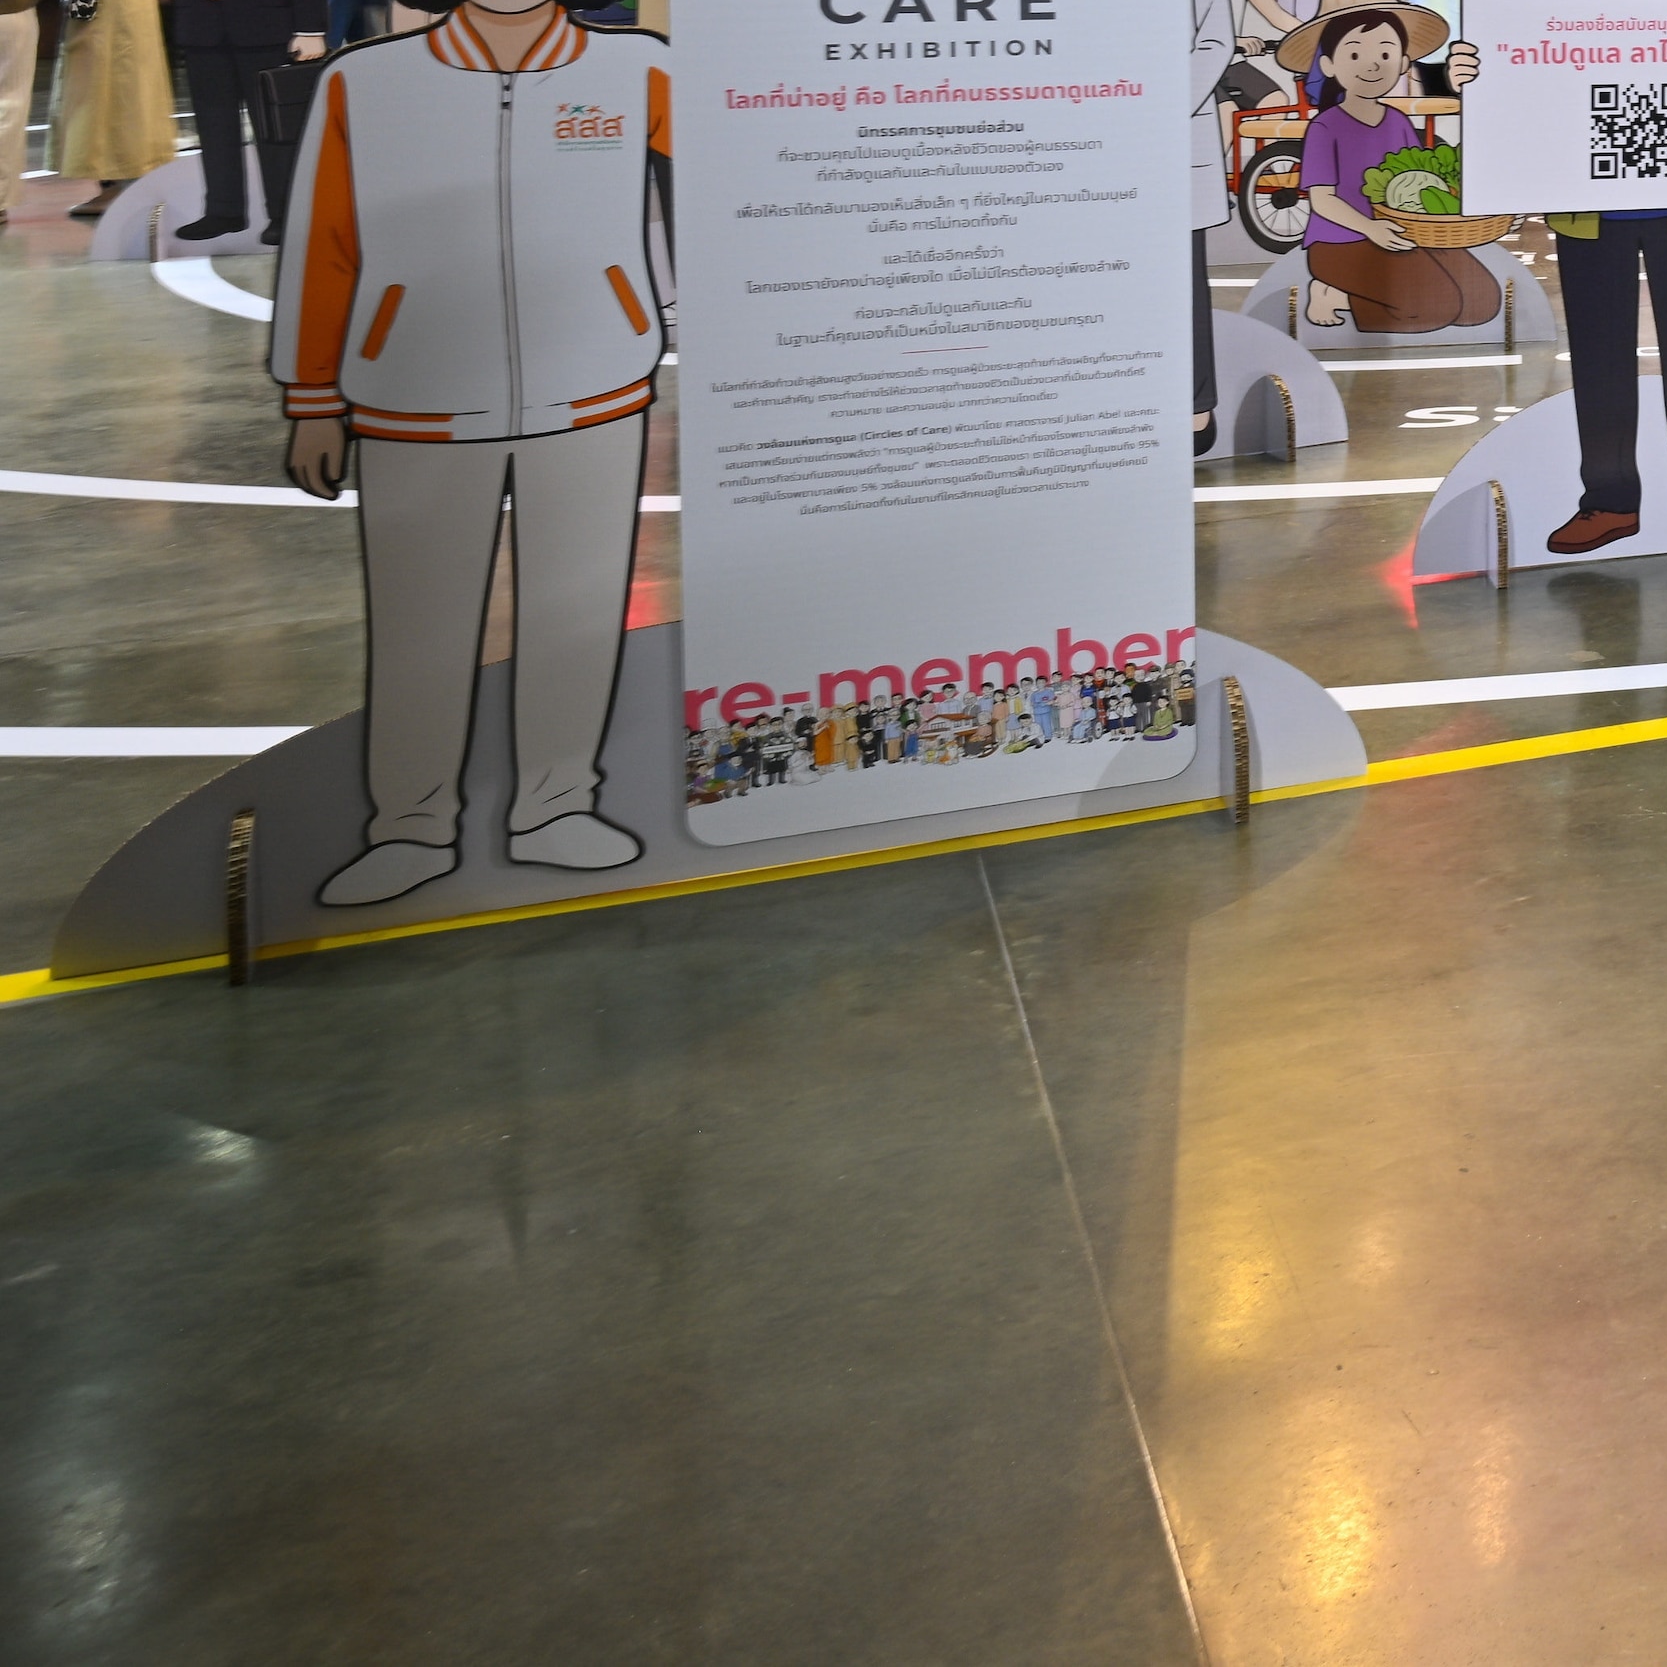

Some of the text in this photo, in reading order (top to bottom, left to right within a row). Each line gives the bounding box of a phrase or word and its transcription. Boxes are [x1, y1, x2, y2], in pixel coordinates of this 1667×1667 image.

[825, 38, 1054, 62] EXHIBITION
[1496, 39, 1622, 72] "ลาไปดูแล
[725, 77, 1143, 112] โลกที่น่าอยู่ คือ โลกที่คนธรรมดาดูแลกัน
[554, 115, 625, 140] สสส
[857, 120, 1025, 138] นิทรรศการชุมชนย่อส่วน
[778, 139, 1103, 163] ที่จะชวนคุณไปแอบดูเบื้องหลังชีวิตของผู้คนธรรมดา
[816, 161, 1064, 184] ที่กำลังดูแลกันและกันในแบบของตัวเอง
[736, 195, 955, 219] เพื่อให้เราได้กลับมามองเห็นสิ่งเล็ก
[973, 187, 1138, 208] ที่ยิ่งใหญ่ในความเป็นมนุษย์
[867, 212, 1018, 233] นั่นคือ การไม่ทอดทิ้งกัน
[883, 245, 1005, 265] และได้เชื่ออีกครั้งว่า
[855, 297, 1033, 320] ก่อนจะกลับไปดูแลกันและกัน
[860, 430, 903, 442] (Circles
[907, 428, 919, 437] of
[921, 424, 953, 435] Care)
[1065, 412, 1096, 425] Julian
[1098, 409, 1122, 421] Abel
[1138, 439, 1161, 449] 95%
[860, 484, 878, 493] 5%
[683, 627, 1196, 731] re-member
